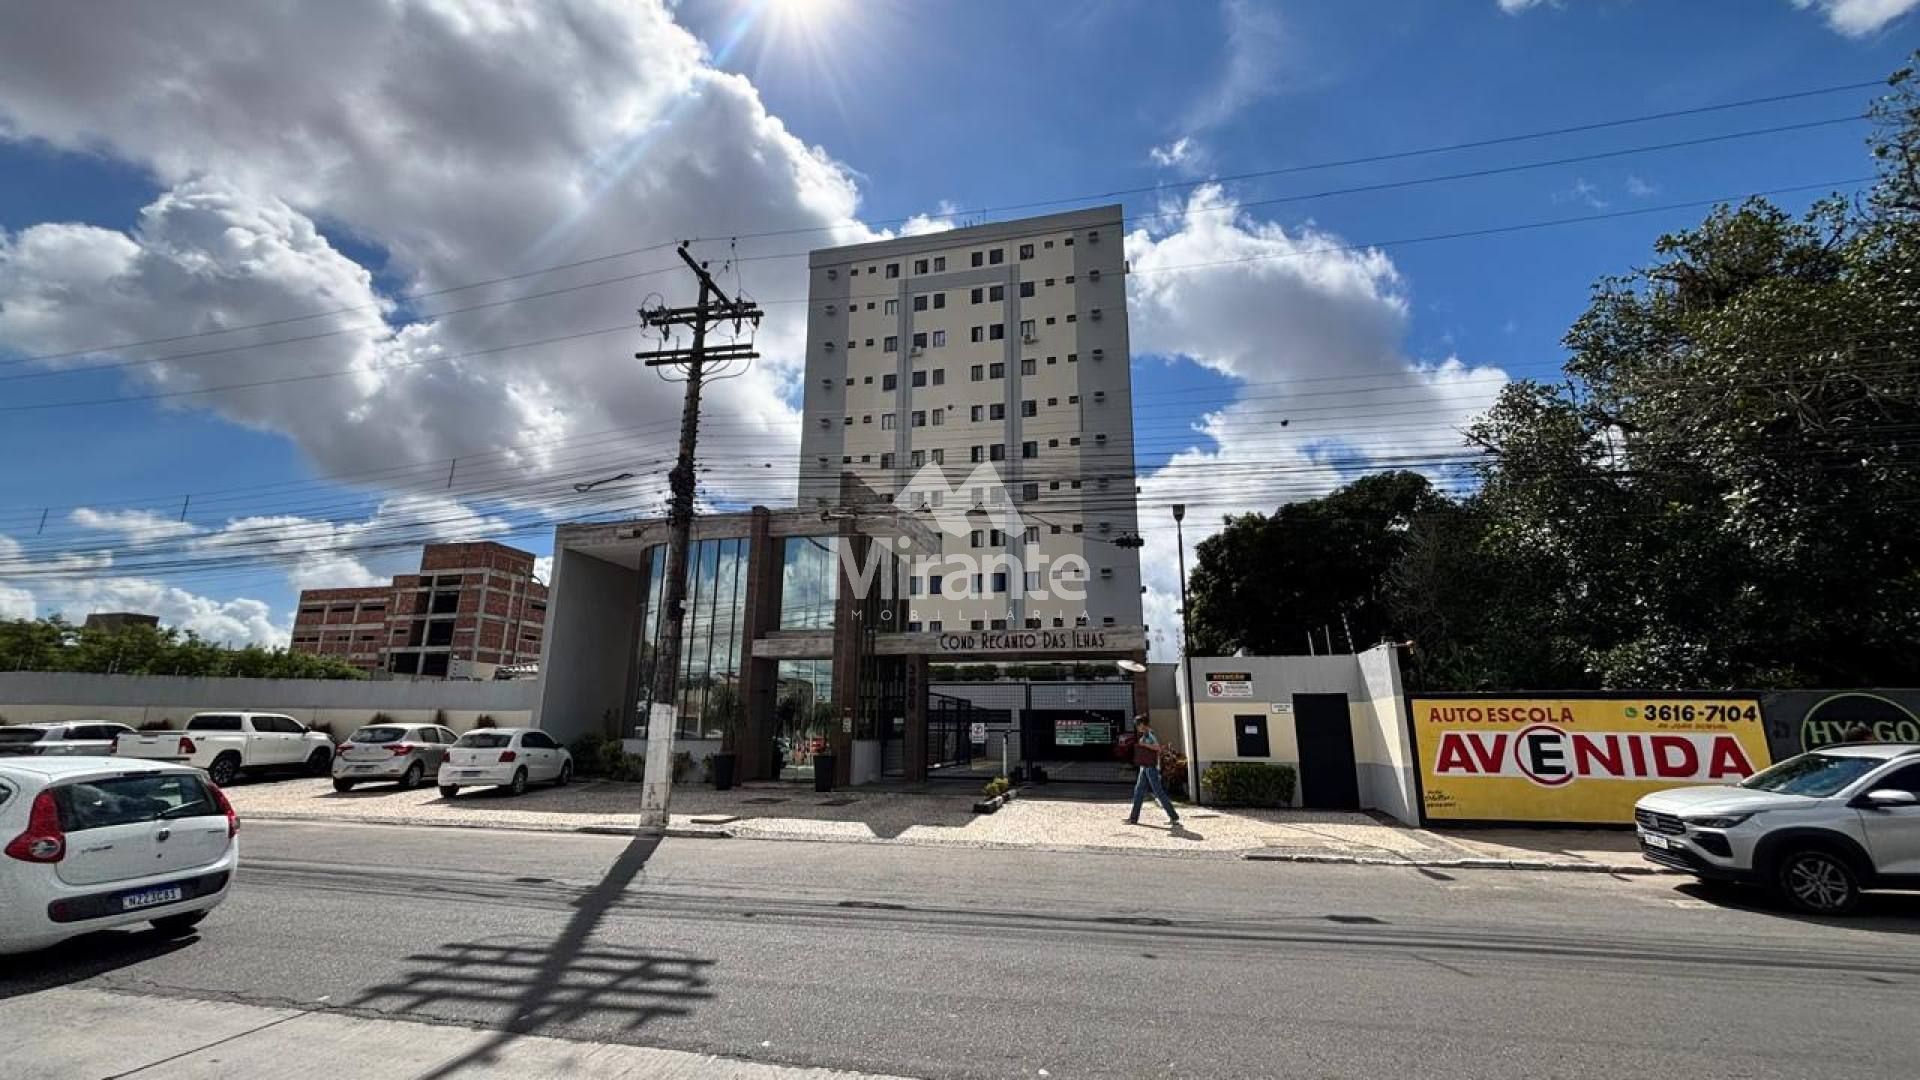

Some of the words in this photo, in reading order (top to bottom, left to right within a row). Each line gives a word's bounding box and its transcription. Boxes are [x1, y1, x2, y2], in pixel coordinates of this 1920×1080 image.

[981, 631, 1036, 649] RECANTO
[1043, 631, 1066, 649] DAS
[1072, 630, 1105, 649] ILHAS
[1430, 708, 1482, 722] AUTO
[1487, 708, 1574, 722] ESCOLA
[1644, 704, 1756, 722] 3616-7104
[1436, 729, 1755, 782] AVENIDA
